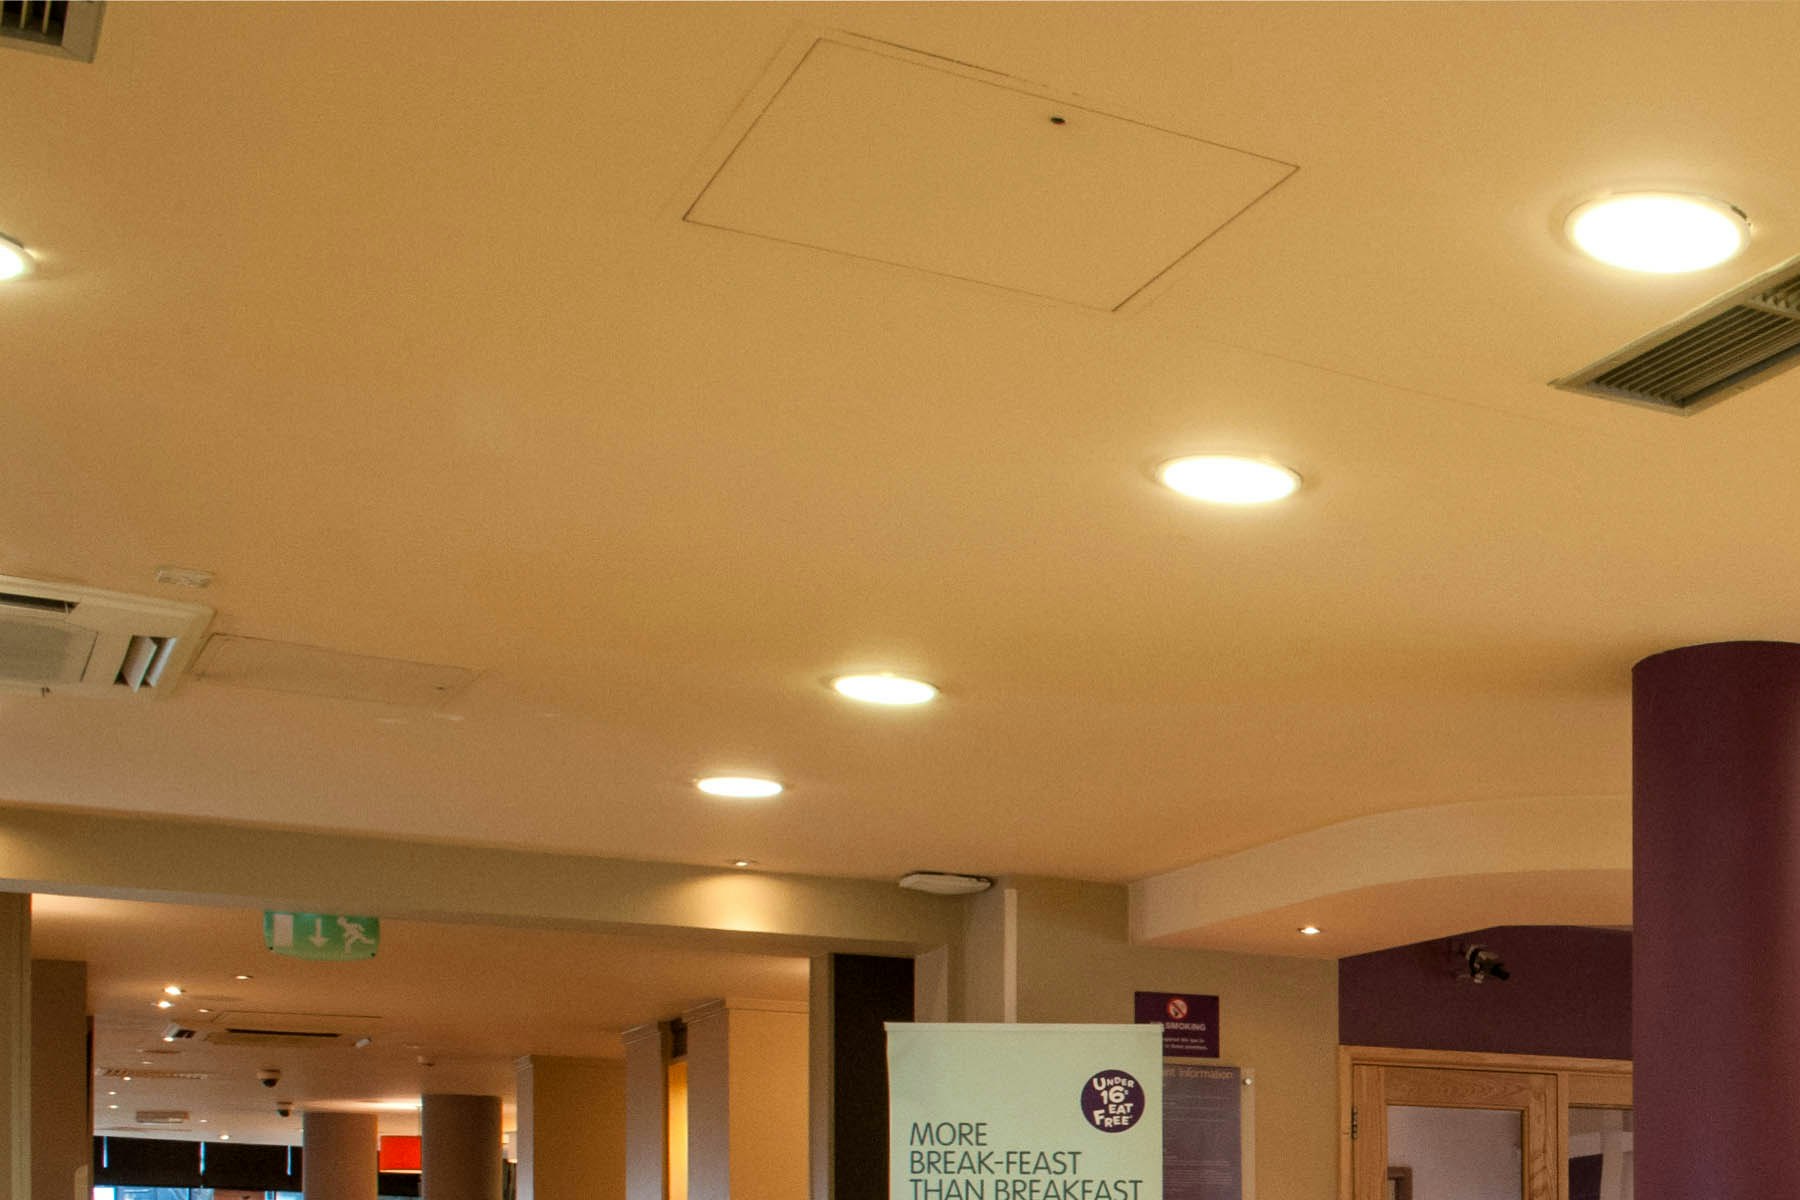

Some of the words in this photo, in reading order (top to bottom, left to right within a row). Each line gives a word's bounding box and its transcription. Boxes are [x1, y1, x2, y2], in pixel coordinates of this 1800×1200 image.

[1165, 1022, 1206, 1032] SMOKING
[1108, 1103, 1134, 1114] EAT
[909, 1121, 988, 1147] MORE
[909, 1150, 1083, 1176] BREAK-FEAST
